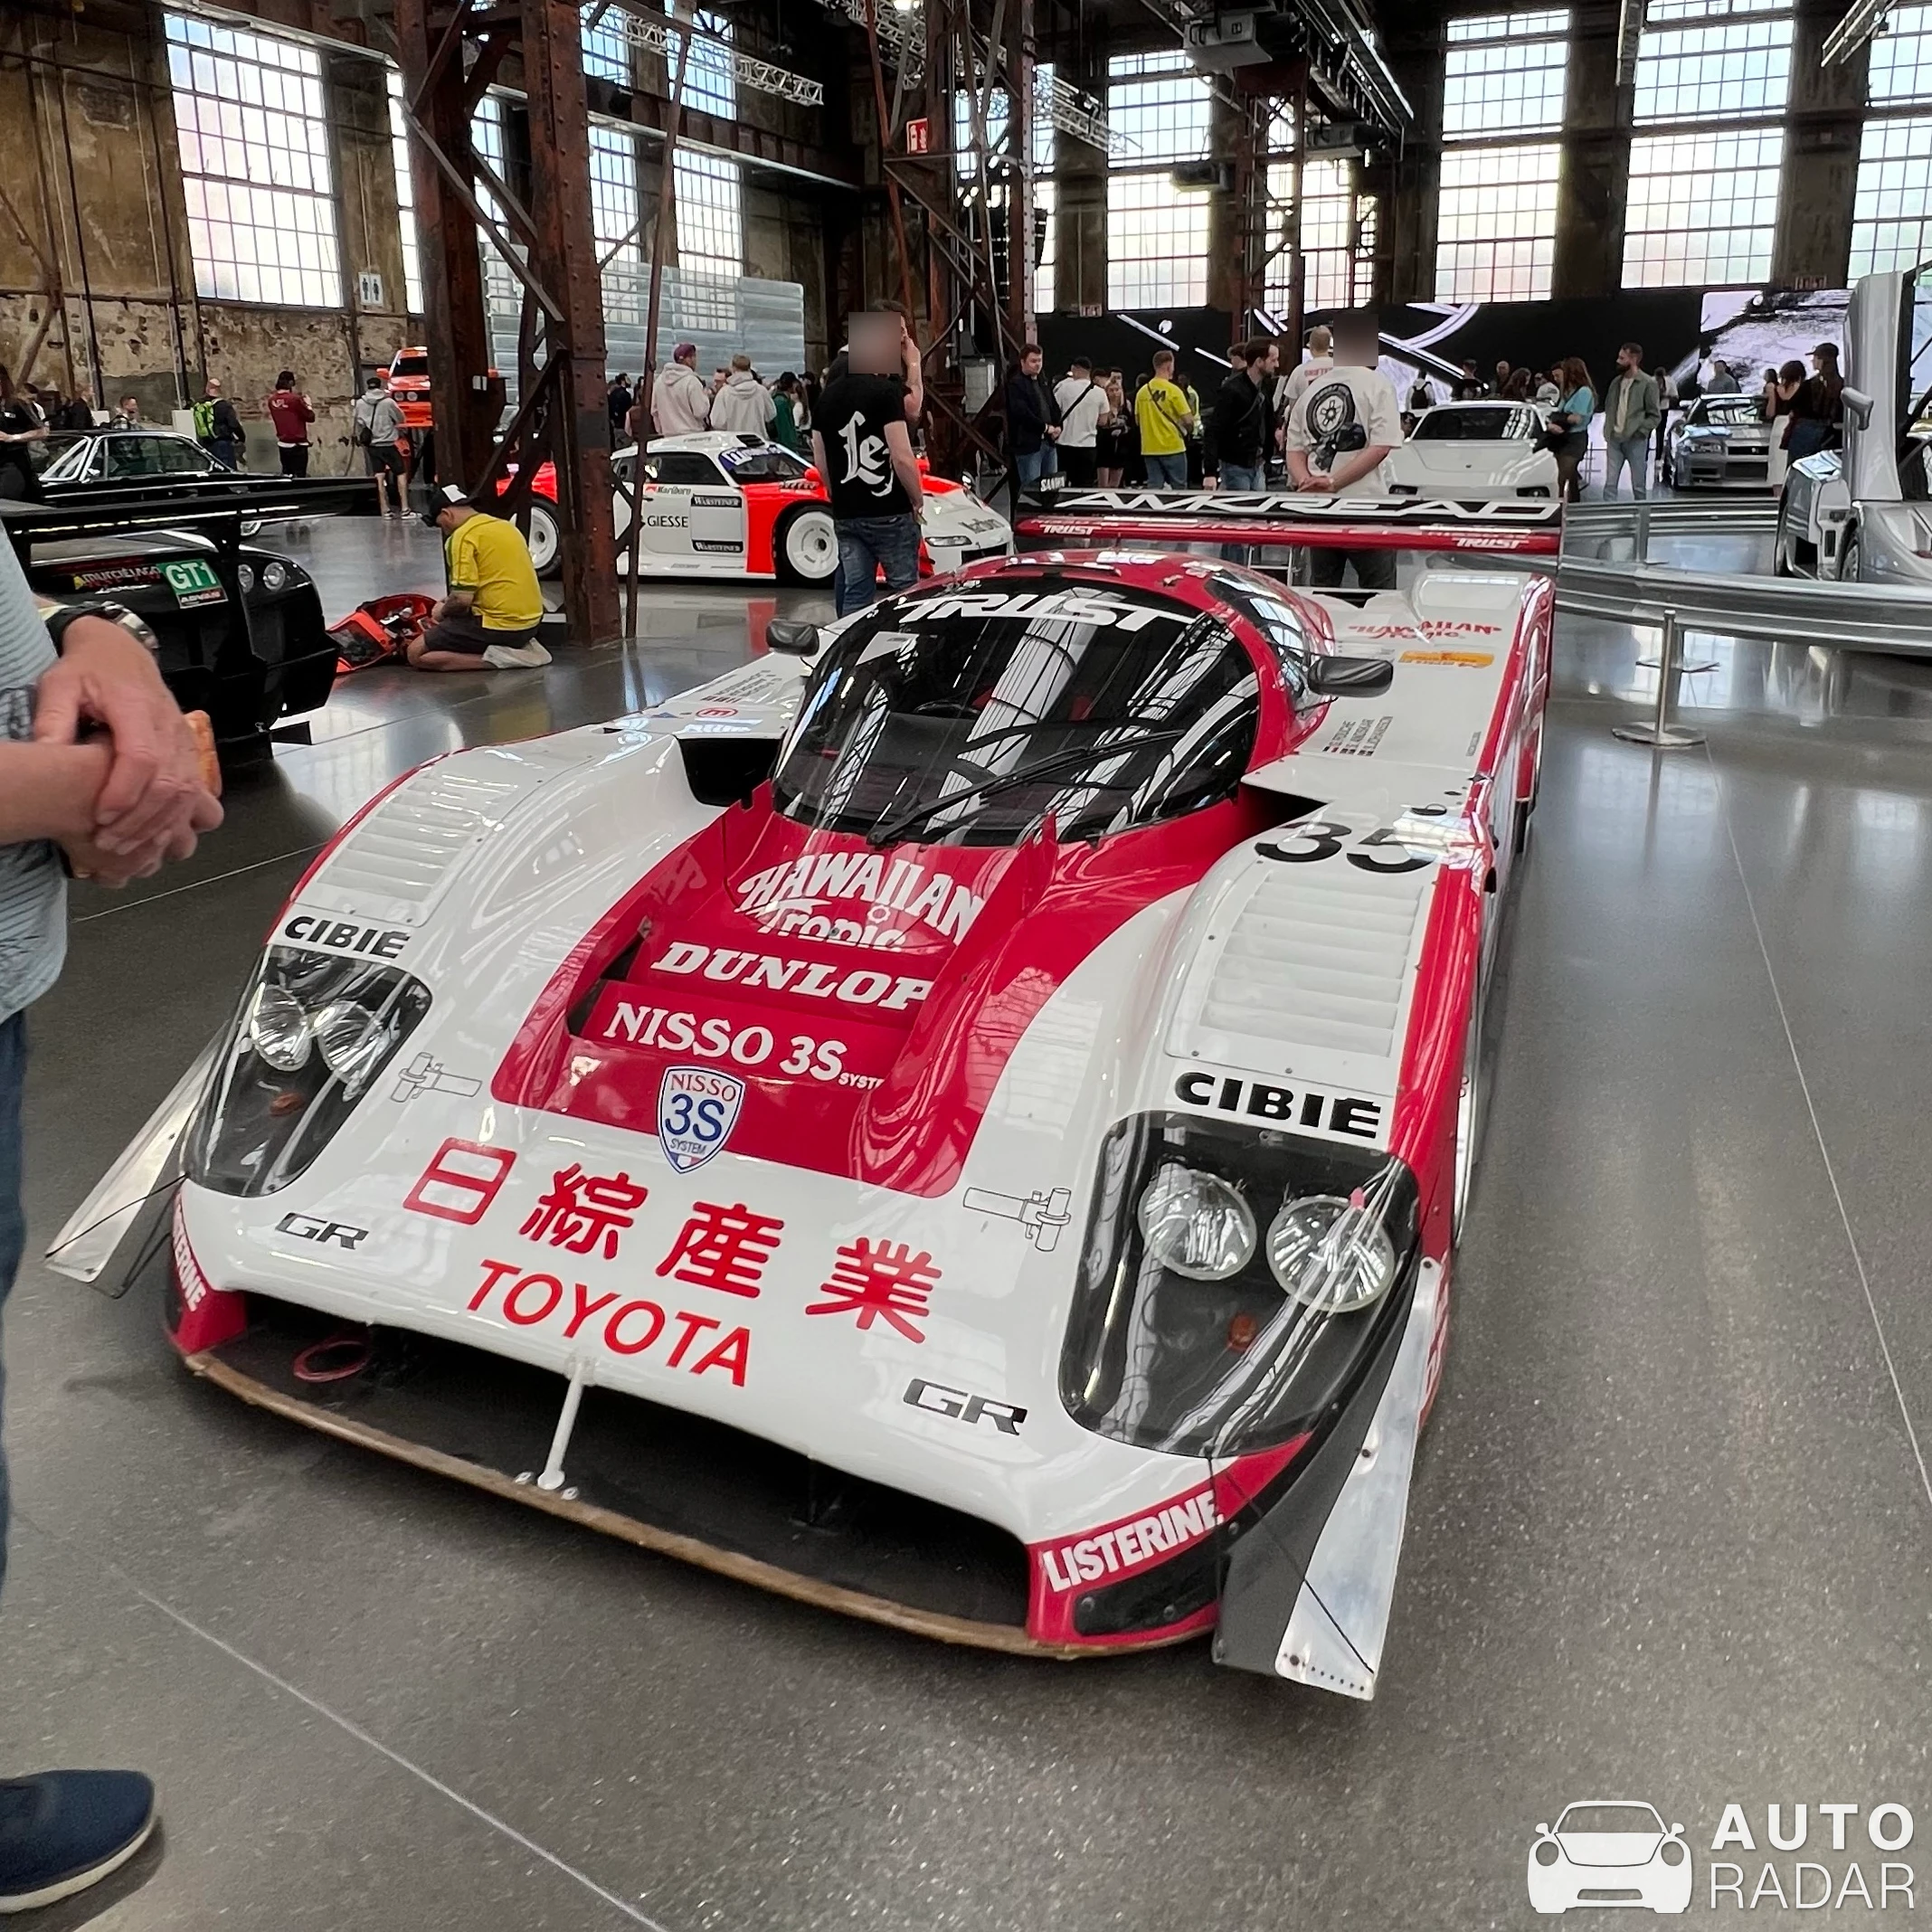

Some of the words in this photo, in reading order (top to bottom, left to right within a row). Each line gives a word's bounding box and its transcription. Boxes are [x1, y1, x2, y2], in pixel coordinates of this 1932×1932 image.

[647, 515, 688, 528] GIESSE
[1039, 525, 1102, 535] TRUST
[1452, 537, 1529, 549] TRUST
[166, 562, 216, 590] GT1
[894, 593, 1196, 632] TRUST
[1255, 821, 1436, 874] 35
[734, 852, 987, 946] HAWAIIAN
[650, 941, 935, 1010] DUNLOP
[602, 1001, 774, 1065] NISSO
[779, 1036, 848, 1082] 3S
[670, 1074, 737, 1102] NISSO
[665, 1094, 725, 1141] 3S
[670, 1138, 707, 1155] SYSTEM
[275, 1212, 369, 1250] GR
[466, 1259, 752, 1387] TOYOTA
[903, 1378, 1028, 1436] GR
